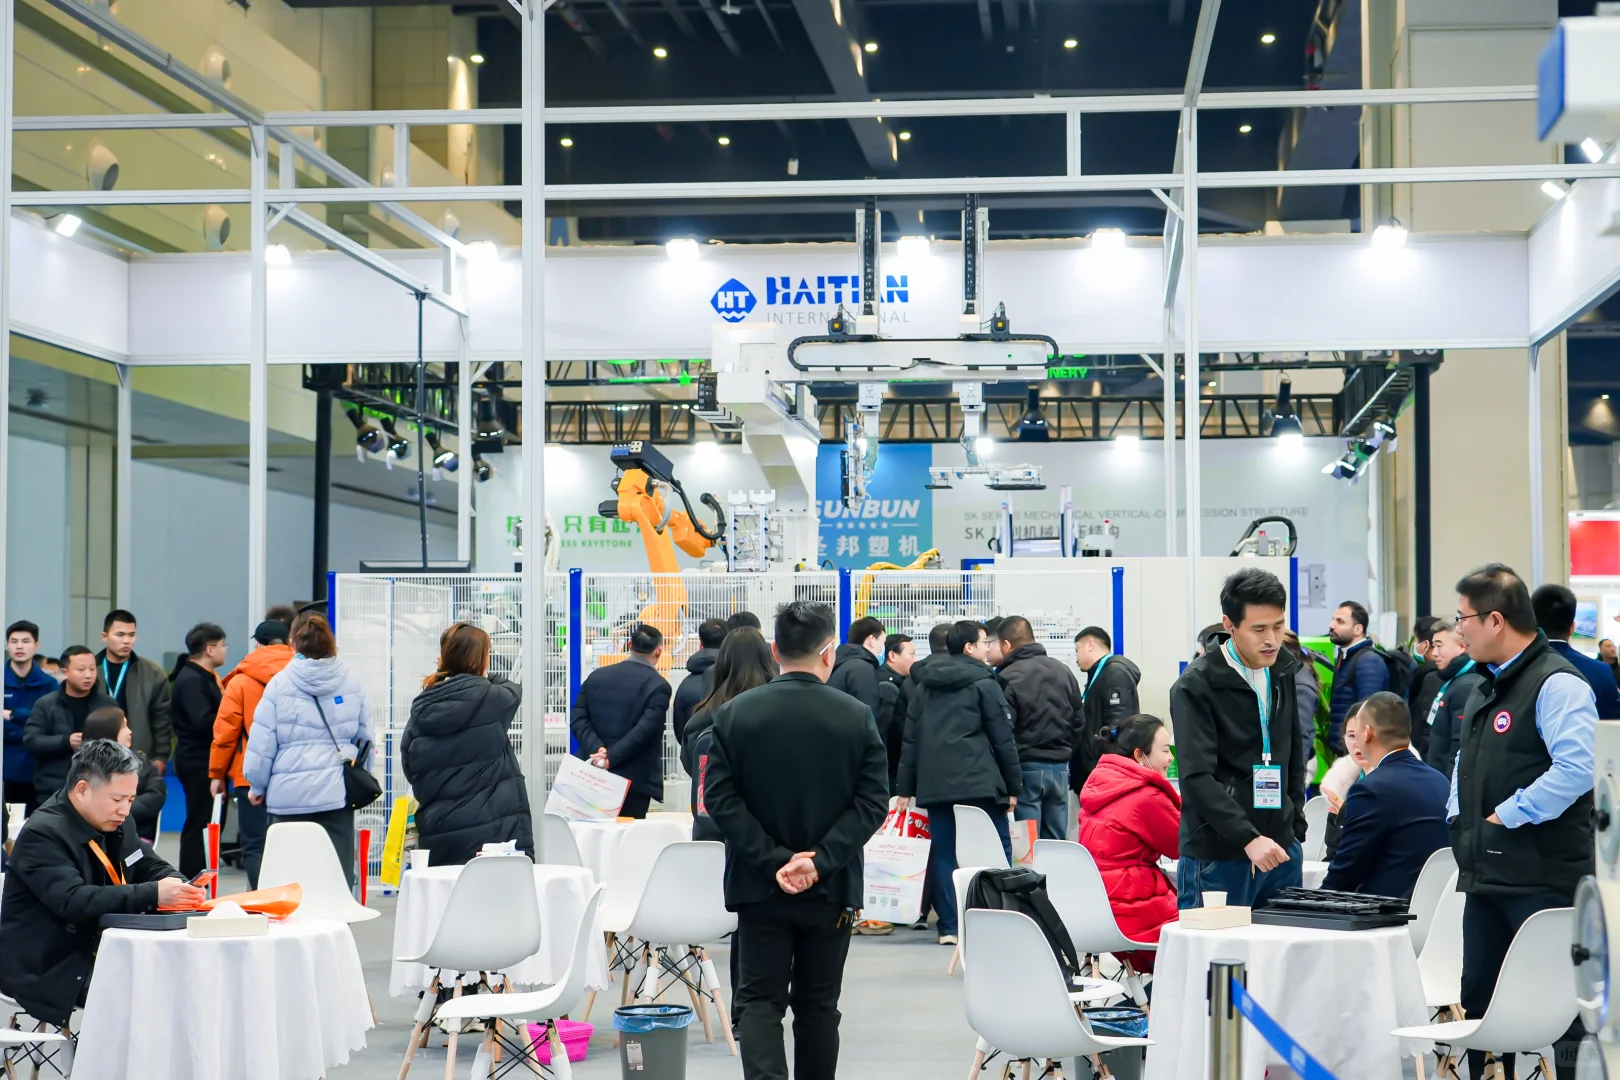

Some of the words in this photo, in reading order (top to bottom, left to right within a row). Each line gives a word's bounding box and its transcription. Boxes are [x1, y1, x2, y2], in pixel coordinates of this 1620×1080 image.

[766, 275, 909, 305] HAITIN
[717, 291, 750, 309] HT
[981, 510, 1021, 520] SERS
[1024, 509, 1095, 520] MECHICAL
[1241, 506, 1309, 517] STRUCTURE
[964, 526, 985, 540] SK
[581, 539, 632, 548] KEYSTONE
